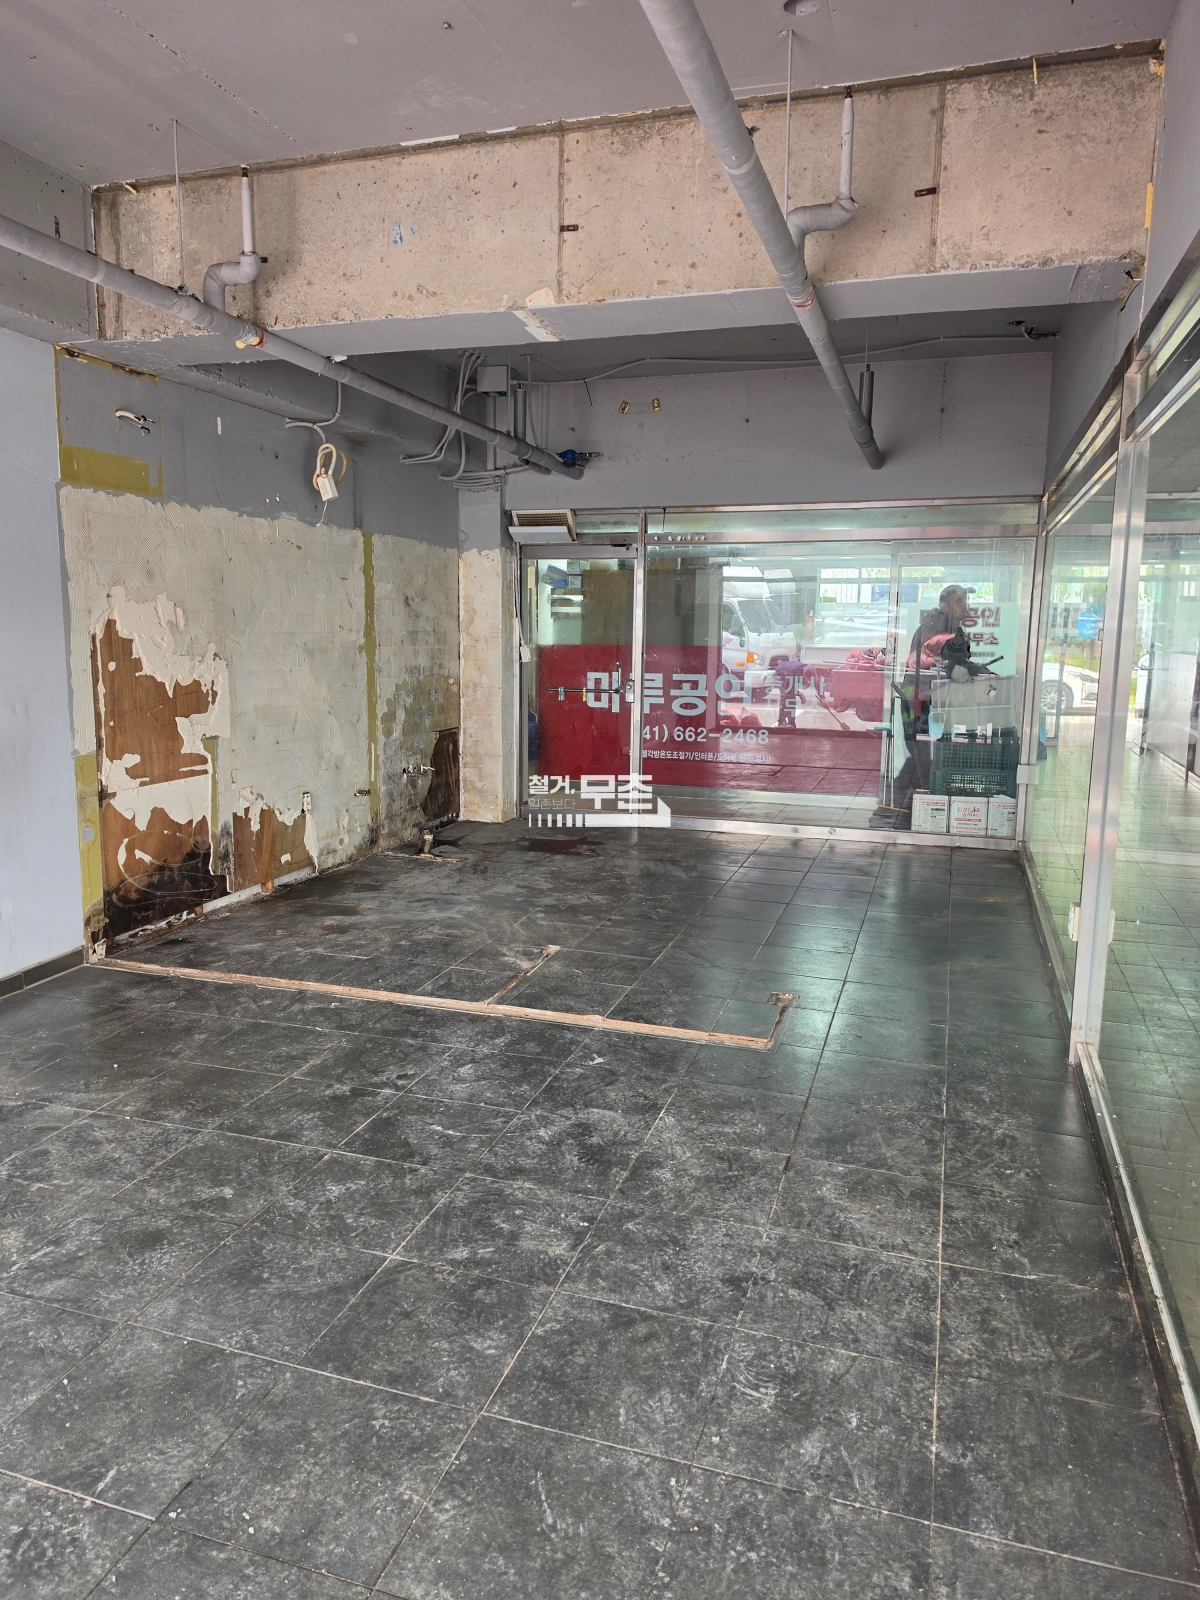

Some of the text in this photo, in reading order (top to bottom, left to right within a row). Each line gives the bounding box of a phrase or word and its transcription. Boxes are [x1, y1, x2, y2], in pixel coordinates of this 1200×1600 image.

[587, 671, 752, 716] 마루공인
[764, 675, 826, 696] 중개사
[642, 724, 669, 743] 41)
